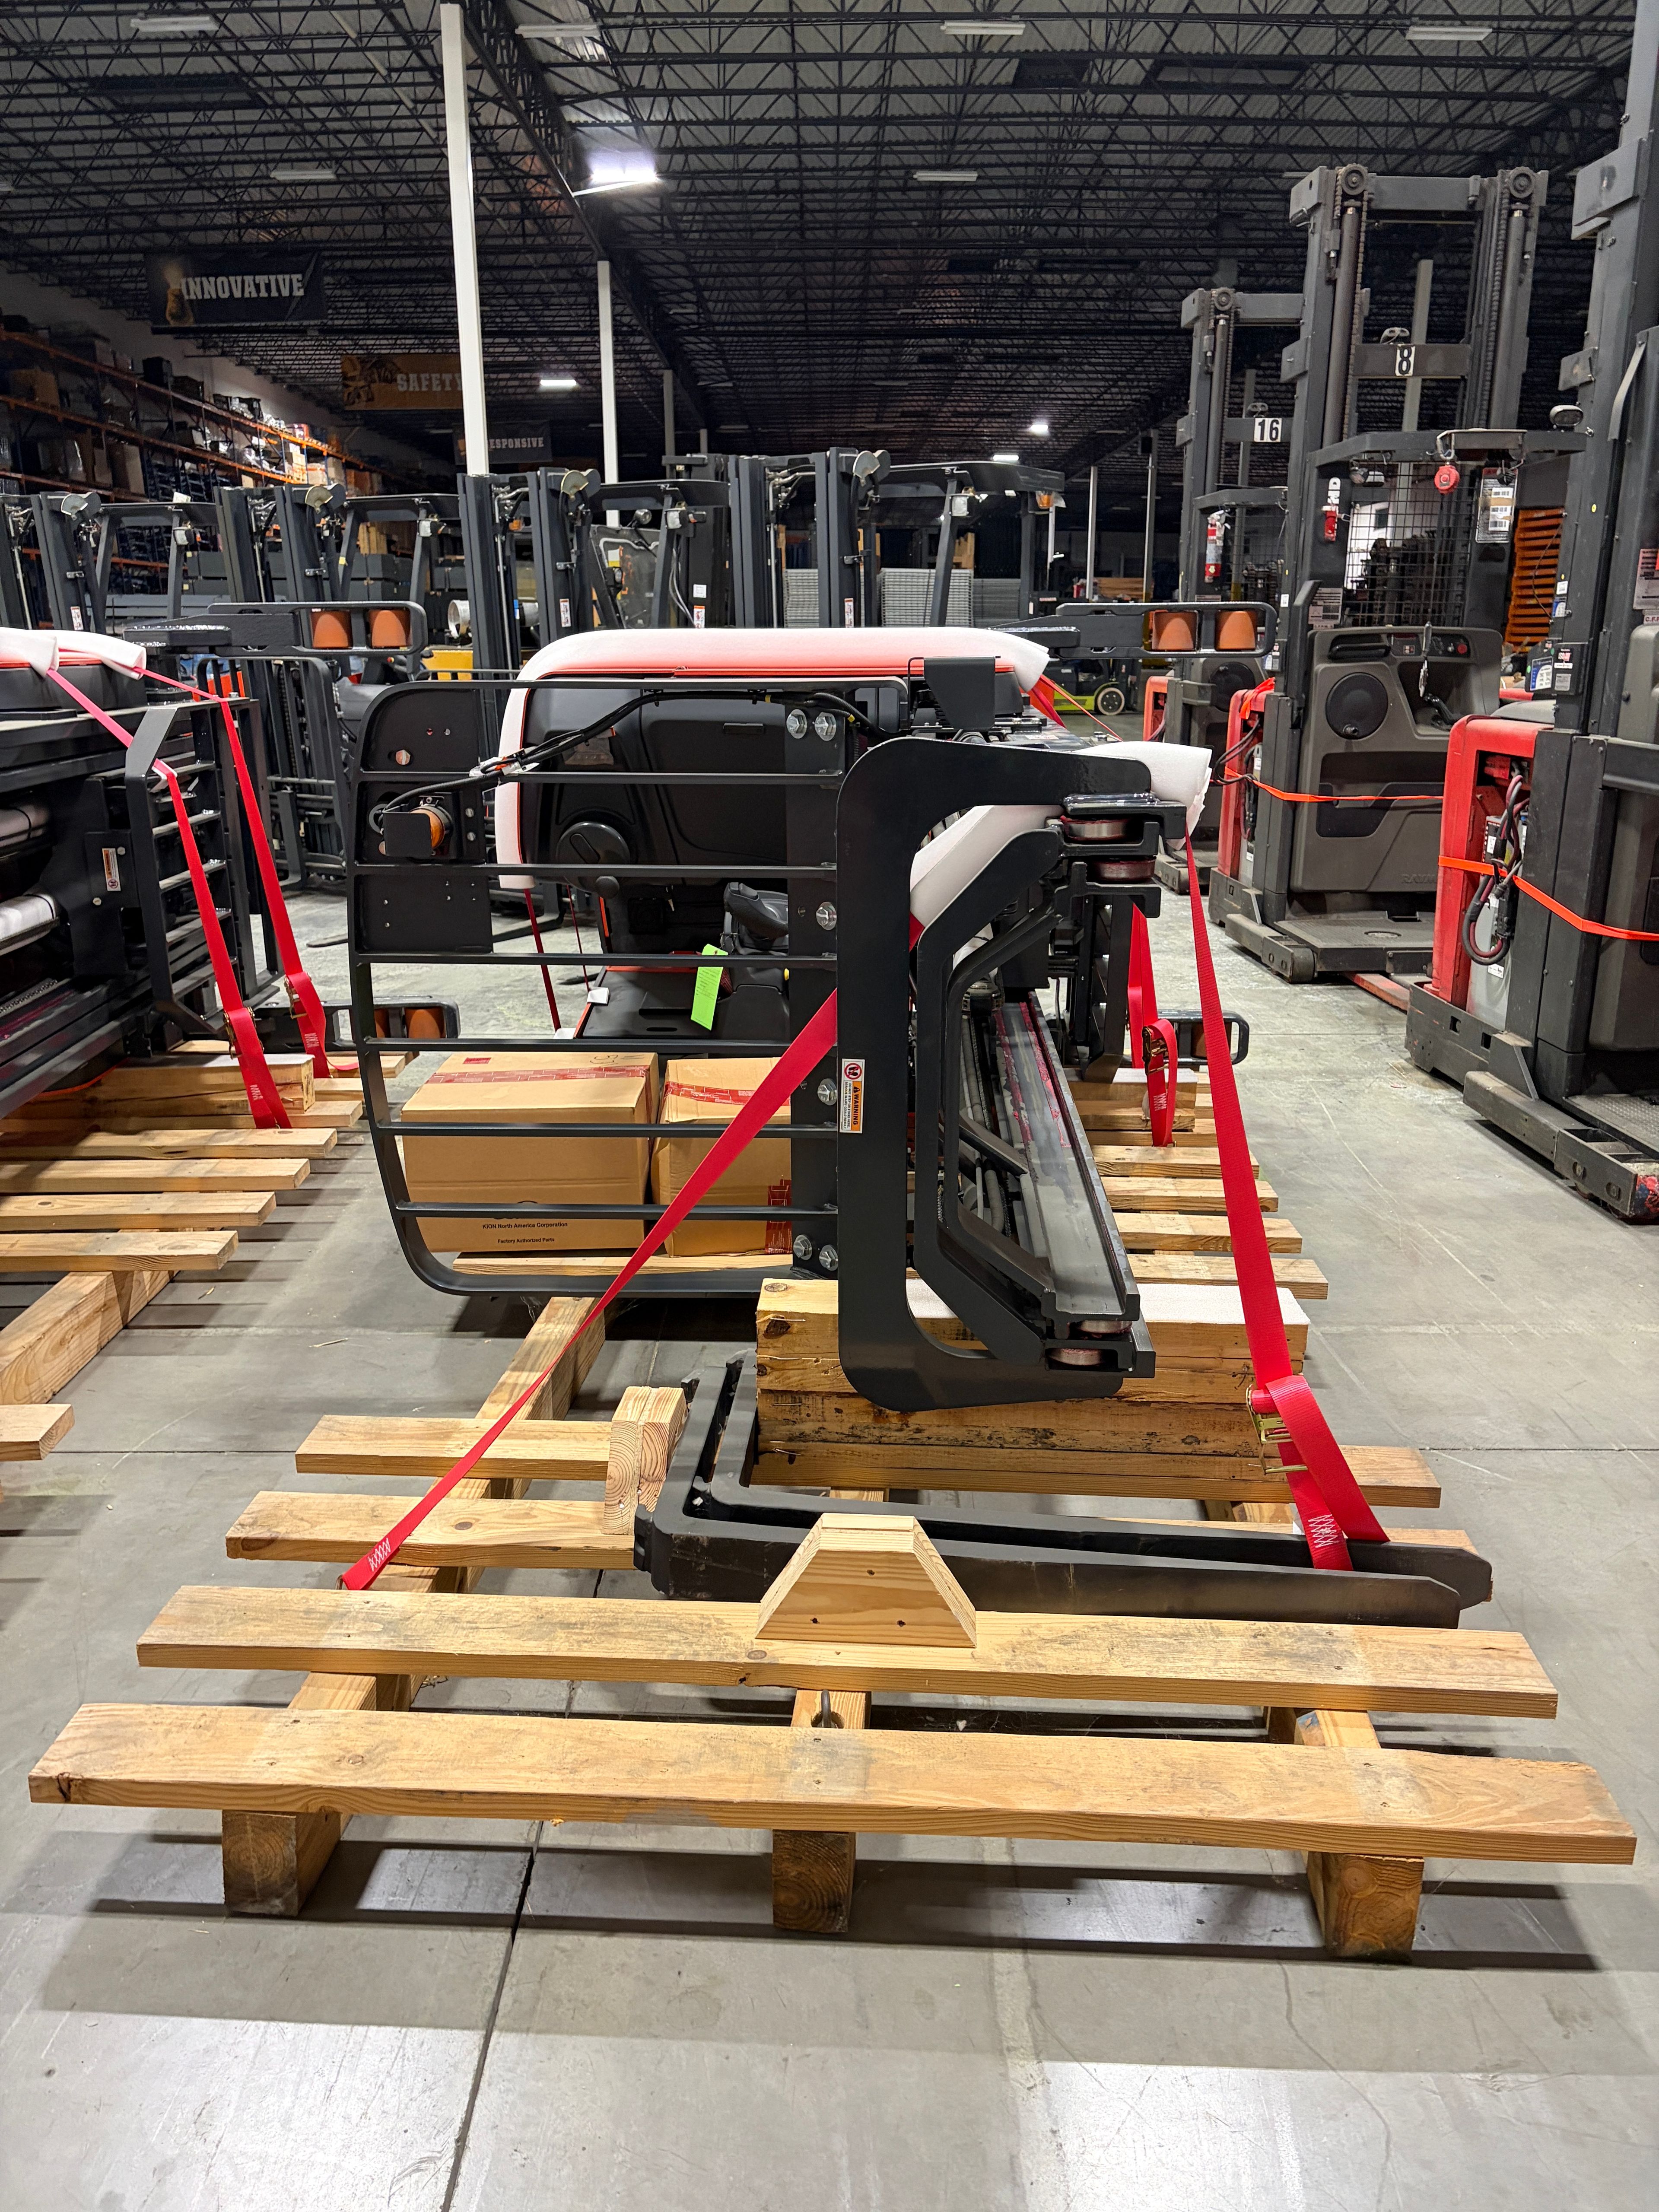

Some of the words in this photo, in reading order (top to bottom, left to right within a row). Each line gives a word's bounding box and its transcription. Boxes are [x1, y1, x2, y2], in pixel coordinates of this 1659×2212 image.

[181, 274, 304, 300] INNOVATIVE
[1398, 346, 1412, 375] 8
[1258, 419, 1279, 441] 16
[489, 437, 544, 449] ESPONSIVE
